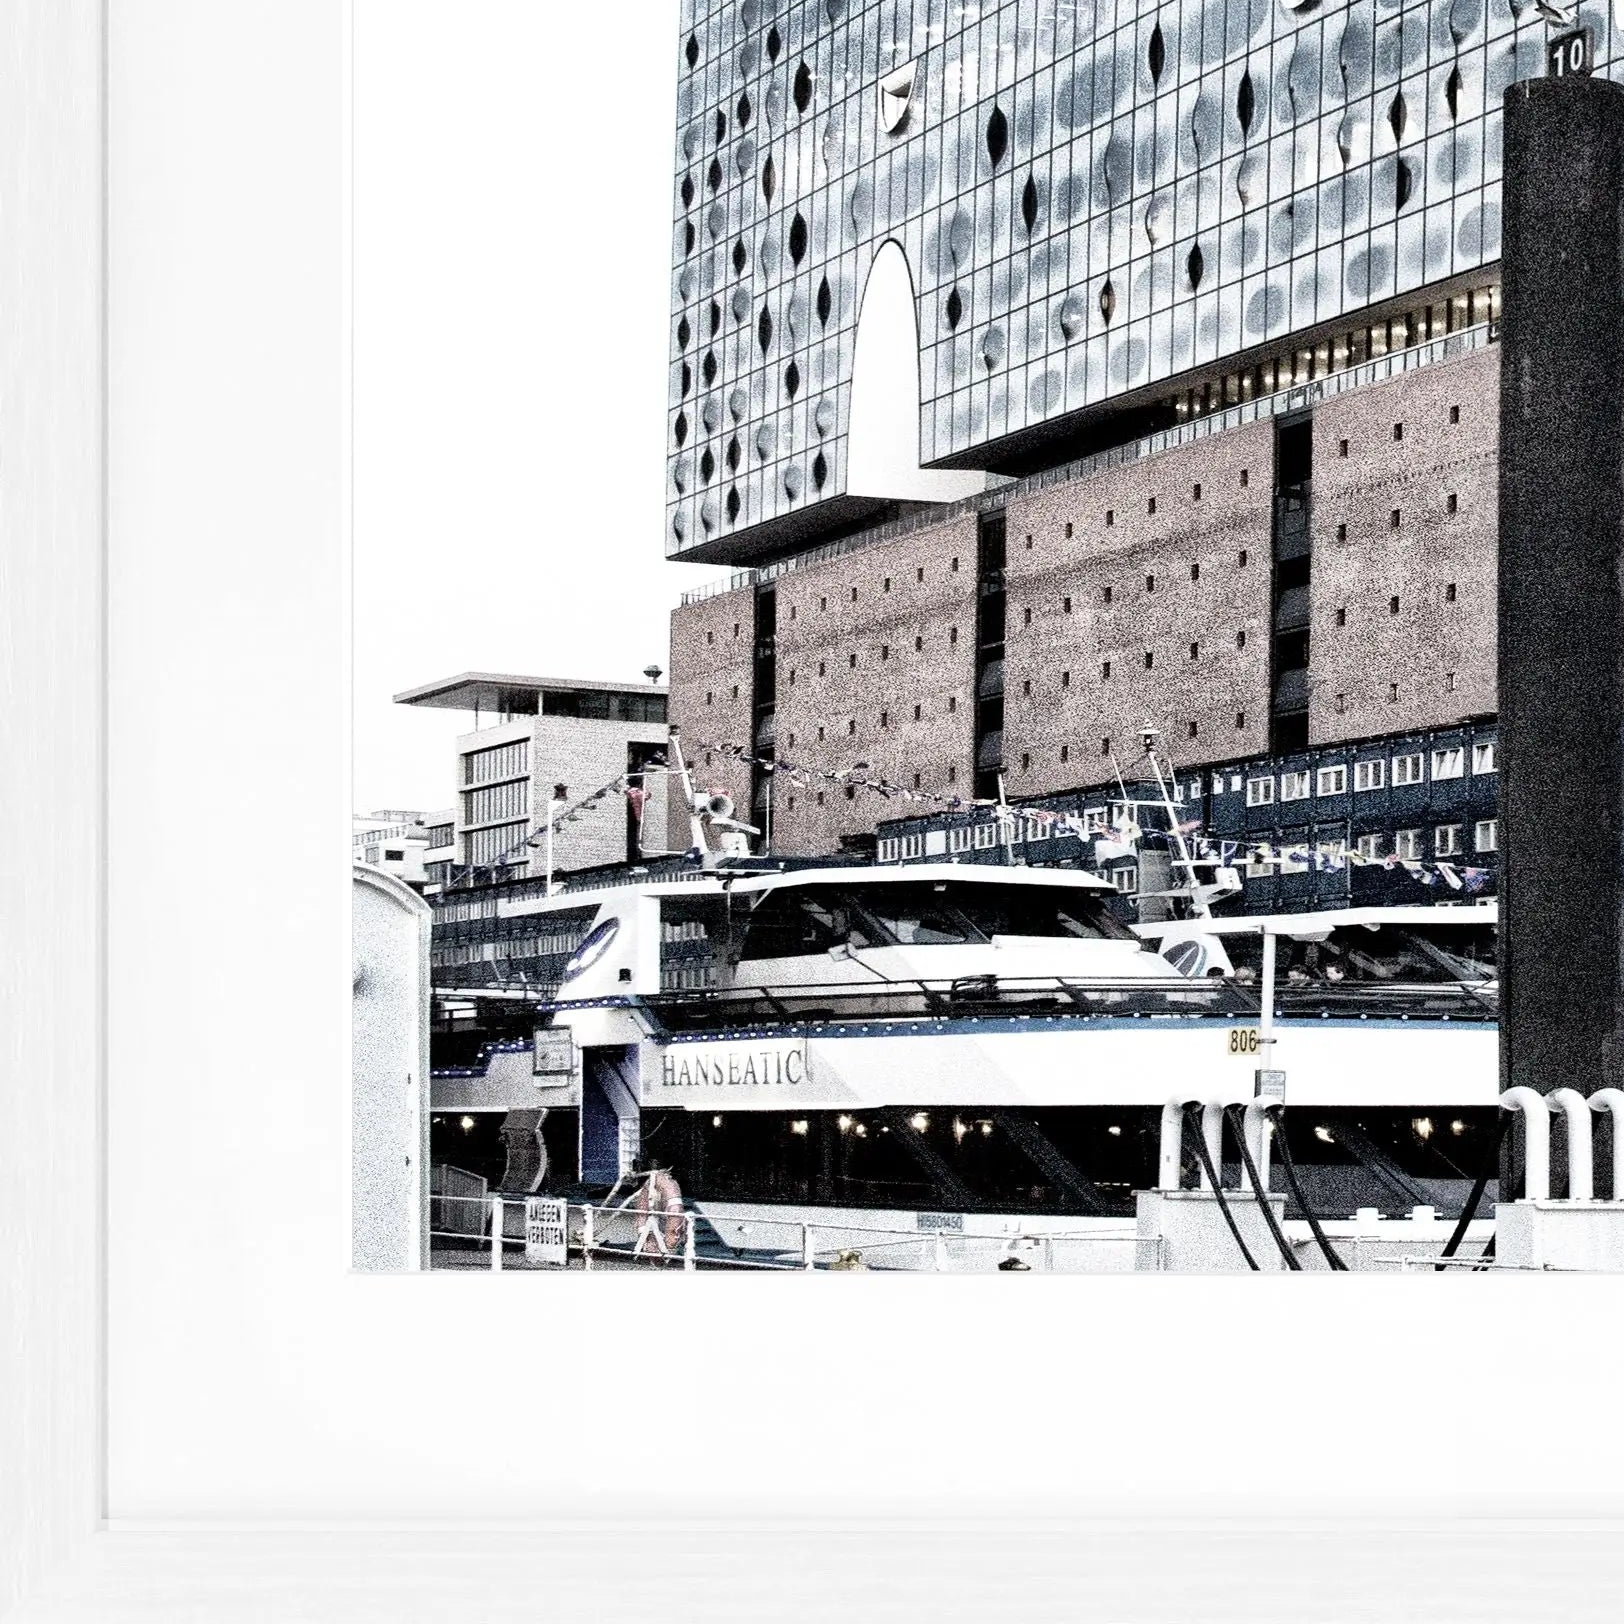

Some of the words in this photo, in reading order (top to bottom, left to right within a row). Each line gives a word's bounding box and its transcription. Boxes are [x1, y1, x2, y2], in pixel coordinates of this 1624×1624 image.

[1553, 38, 1583, 77] 10
[1231, 1030, 1257, 1053] 806
[661, 1050, 801, 1086] HANSEATIC
